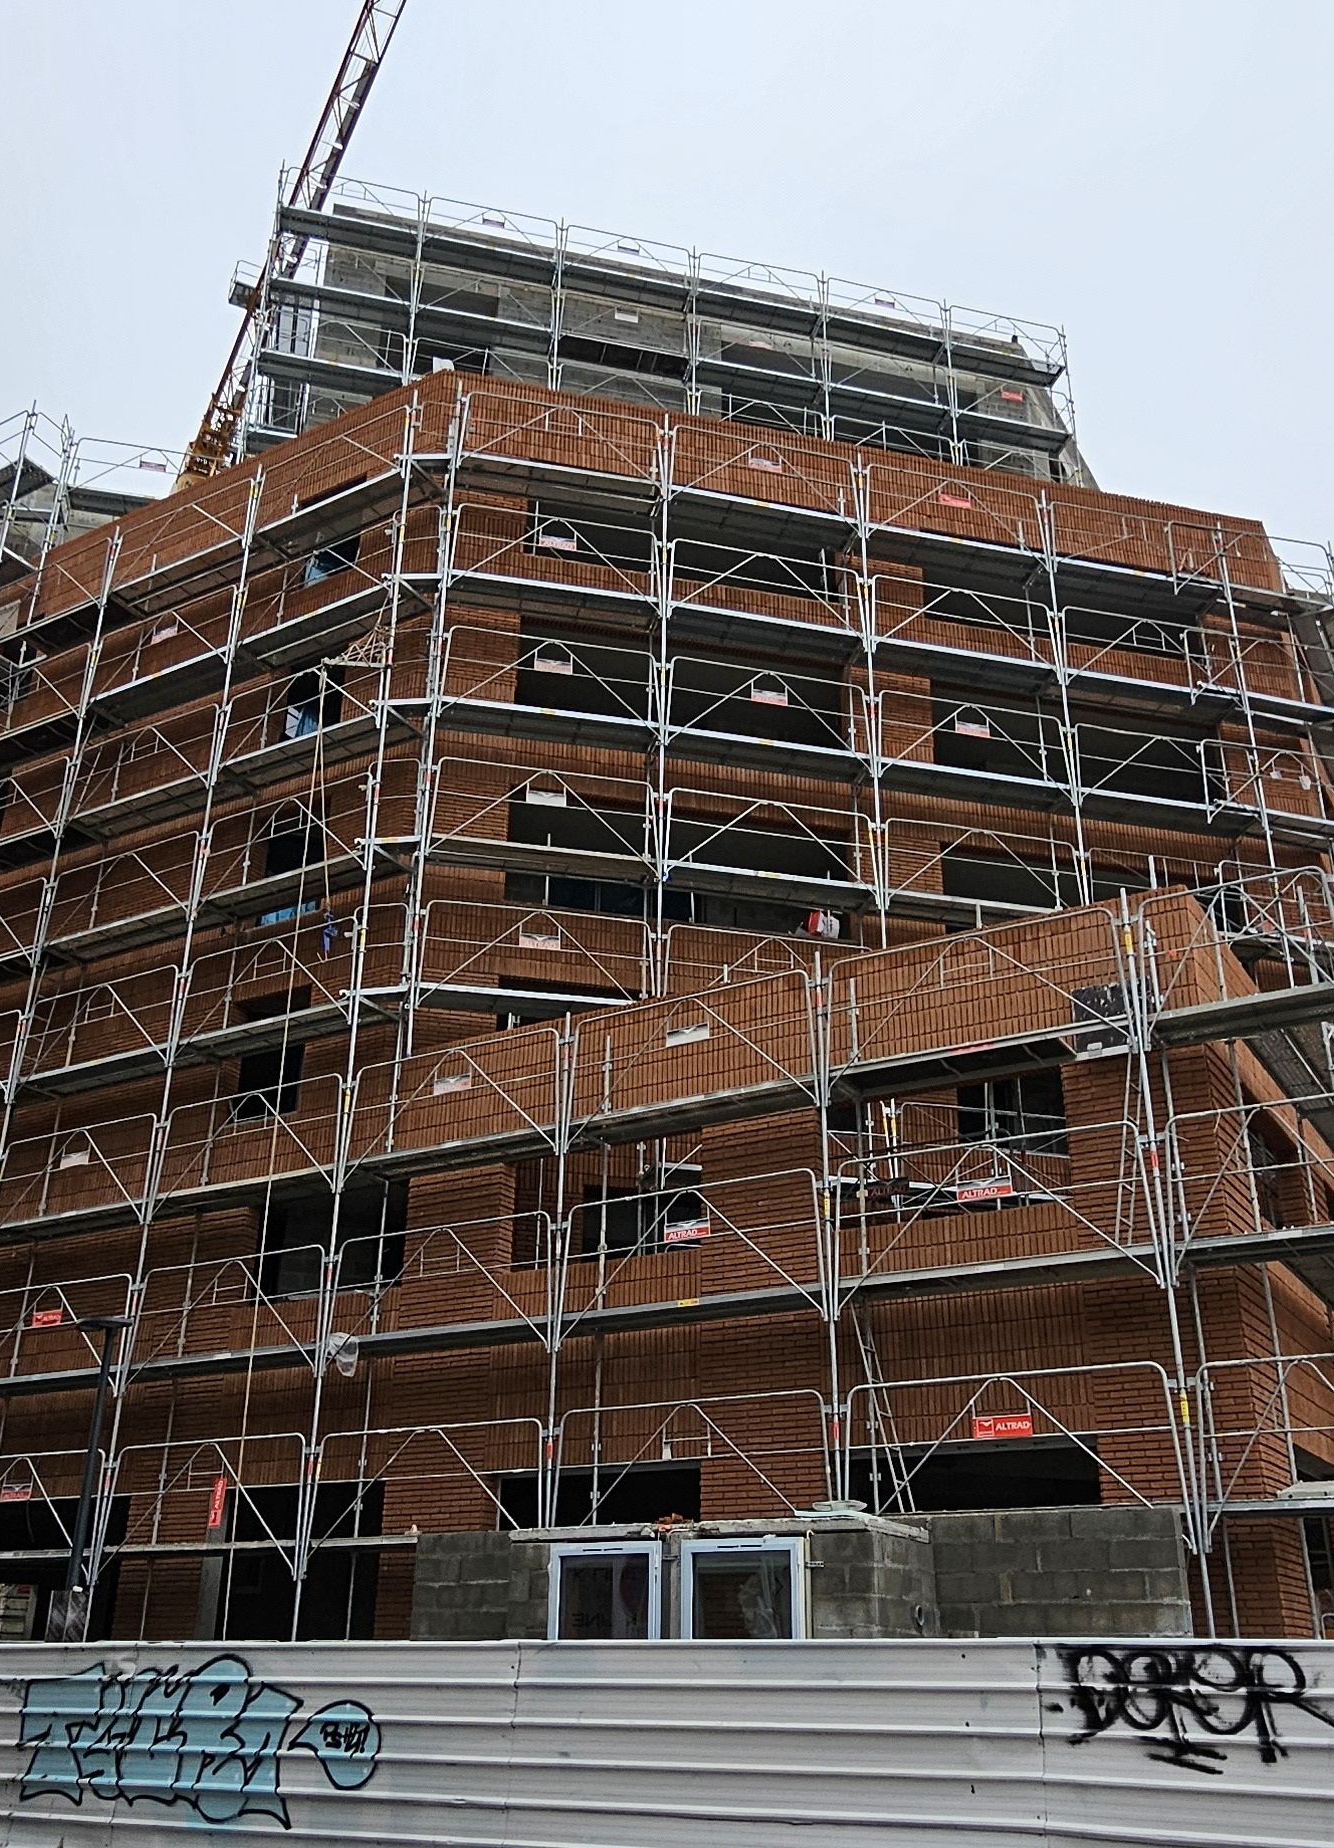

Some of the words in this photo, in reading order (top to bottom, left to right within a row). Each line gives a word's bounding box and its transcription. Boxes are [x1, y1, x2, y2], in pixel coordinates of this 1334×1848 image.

[961, 1187, 998, 1199] ALTRAD
[667, 1229, 698, 1240] ALTRAD
[995, 1421, 1031, 1431] ALTRAD
